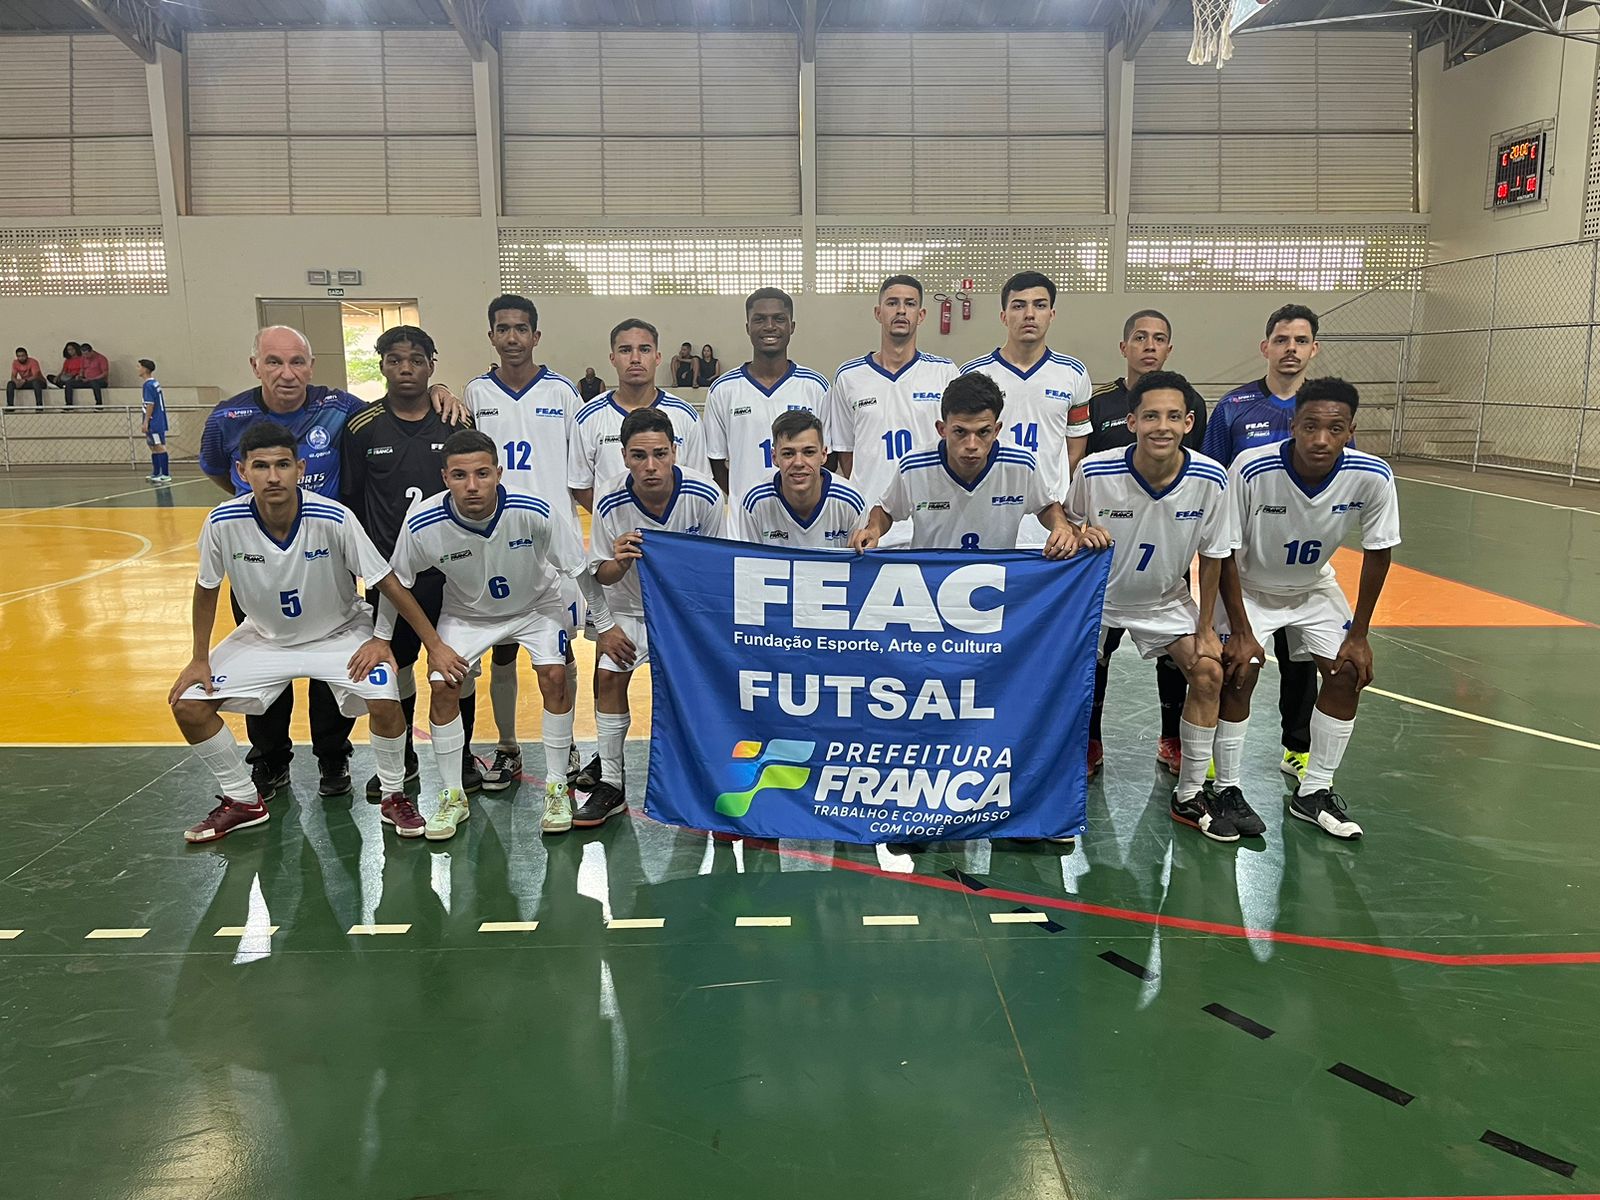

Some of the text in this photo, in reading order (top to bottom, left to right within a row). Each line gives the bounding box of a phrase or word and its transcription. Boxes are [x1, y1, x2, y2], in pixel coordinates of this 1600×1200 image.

[1045, 389, 1071, 399] FEAC
[536, 407, 563, 415] FEAC
[1010, 423, 1039, 452] 14
[1245, 422, 1270, 430] FEAC
[503, 441, 532, 470] 12
[759, 438, 773, 468] 1
[881, 429, 913, 460] 10
[991, 495, 1024, 503] FEAC
[1332, 501, 1364, 512] FEAC
[960, 532, 980, 549] 8
[1283, 540, 1322, 565] 16
[1136, 543, 1155, 571] 7
[488, 576, 511, 599] 6
[733, 556, 1006, 634] FEAC
[279, 589, 303, 618] 5
[733, 631, 1002, 654] Fundação Esporte, Arte e Cultura
[367, 664, 388, 686] 5
[738, 669, 995, 721] FUTSAL
[825, 741, 1012, 769] PREFEITURA
[814, 765, 1011, 813] FRANCA
[814, 804, 1011, 825] TRABALHO E COMPROMISSO
[869, 821, 945, 837] COM VOCÊ
